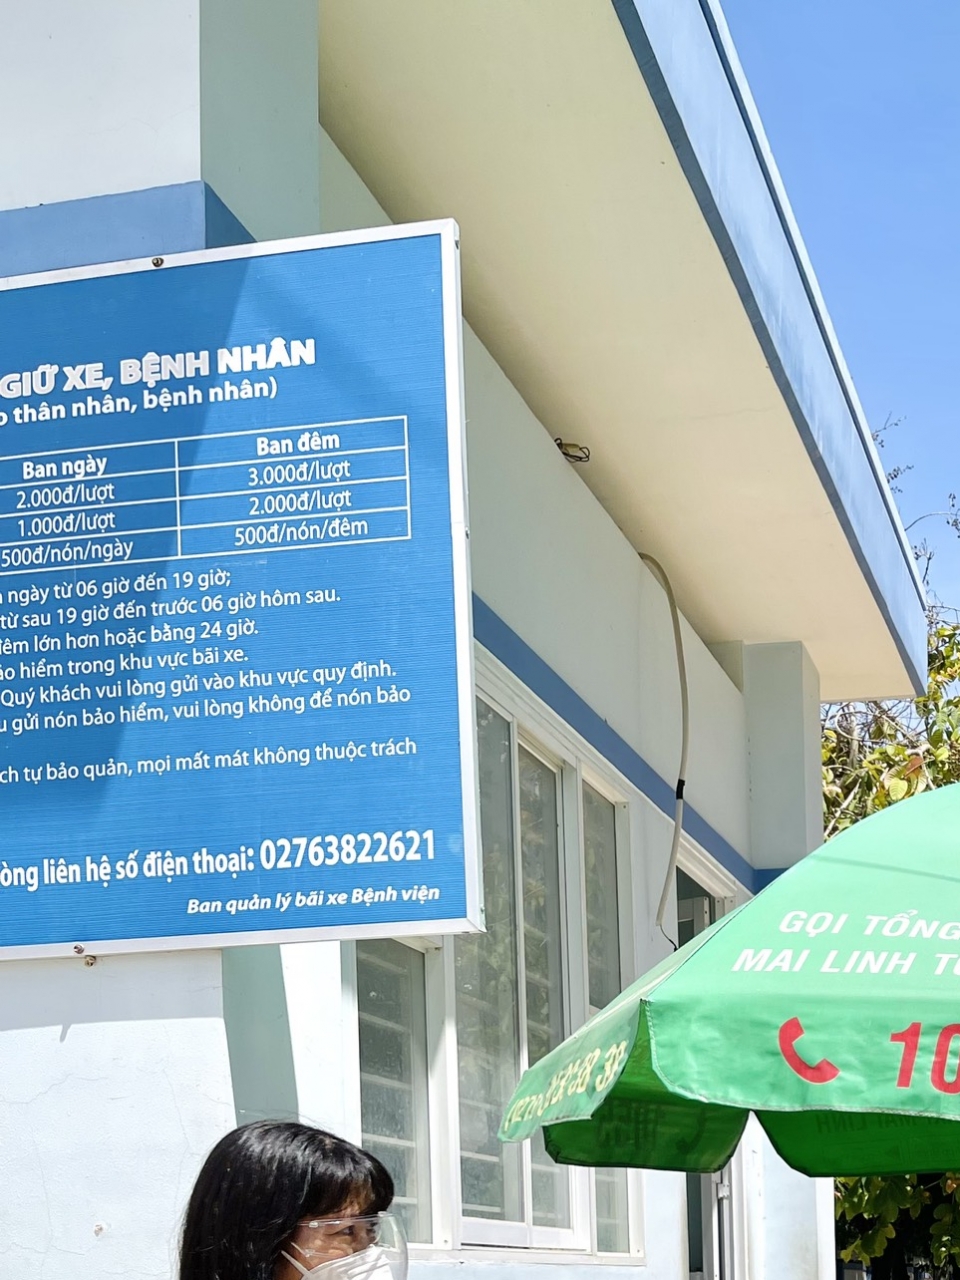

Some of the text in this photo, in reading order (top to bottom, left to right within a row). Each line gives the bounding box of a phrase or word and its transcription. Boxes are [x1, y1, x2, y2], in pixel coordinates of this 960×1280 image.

[0, 336, 316, 399] GIỮ XE, BỆNH NHÂN
[13, 403, 66, 424] thân
[71, 396, 137, 417] nhân,
[143, 385, 202, 412] bệnh
[209, 376, 278, 402] nhân)
[22, 431, 340, 480] Ban ngày Ban đêm
[16, 460, 351, 509] 2.000đ/lượt 3.000đ/lượt
[18, 490, 352, 537] 1.000đ/lượt 2.000đ/lượt
[1, 517, 368, 568] 500đ/nón/ngày 500đ/nón/đêm
[0, 589, 341, 629] từ sau 19 giờ đến trước 06 giờ hôm sau.
[8, 569, 231, 606] ngày từ 06 giờ đến 19 giờ;
[0, 618, 259, 655] êm lớn hơn hoặc bằng 24 giờ.
[1, 659, 397, 708] Quý khách vui lòng gửi vào khu vực quy định.
[20, 647, 248, 679] hiểm trong khu vực bãi xe.
[12, 713, 39, 735] gửi
[44, 711, 77, 729] nón
[82, 708, 115, 726] bảo
[120, 702, 169, 722] hiểm,
[173, 701, 199, 718] vui
[204, 699, 244, 718] lòng
[249, 695, 305, 714] không
[309, 687, 332, 709] để
[337, 688, 372, 706] nón
[376, 685, 411, 704] bảo
[23, 766, 42, 785] tự
[46, 762, 79, 781] bảo
[83, 758, 133, 781] quản,
[137, 755, 171, 776] mọi
[175, 750, 210, 771] mất
[214, 750, 250, 769] mát
[254, 746, 310, 766] không
[314, 741, 367, 762] thuộc
[371, 737, 417, 757] trách
[43, 857, 81, 884] liên
[85, 854, 111, 888] hệ
[115, 849, 139, 880] số
[143, 850, 188, 884] điện
[192, 845, 255, 880] thoại:
[260, 829, 435, 870] 02763822621
[187, 884, 440, 915] Ban quản lý bãi xe Bệnh viện
[778, 910, 849, 938] GỌI
[731, 948, 811, 972] MAI
[819, 949, 917, 974] LINH
